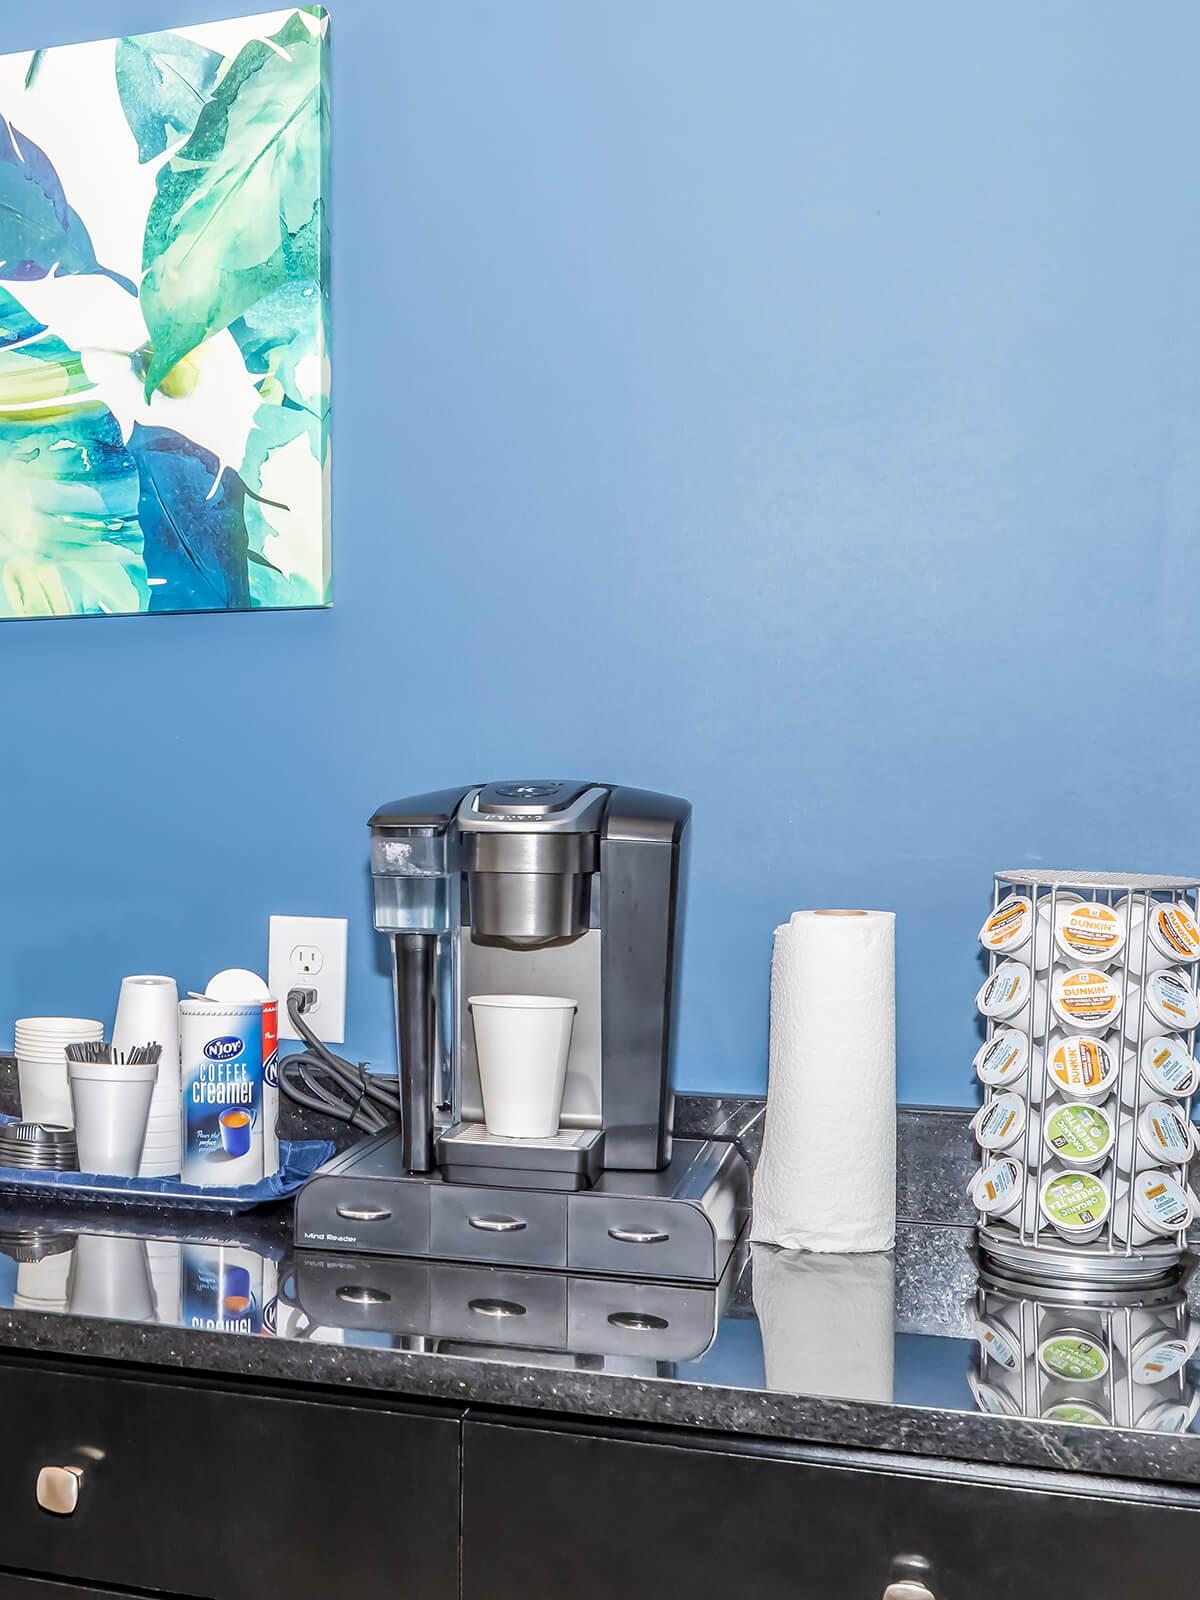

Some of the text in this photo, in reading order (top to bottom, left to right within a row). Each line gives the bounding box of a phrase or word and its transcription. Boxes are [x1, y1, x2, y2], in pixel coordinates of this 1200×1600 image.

[199, 1063, 248, 1082] COFFEE
[192, 1080, 255, 1105] creamer
[1060, 1195, 1098, 1217] ORGANIC
[304, 1231, 357, 1243] Mind Reader
